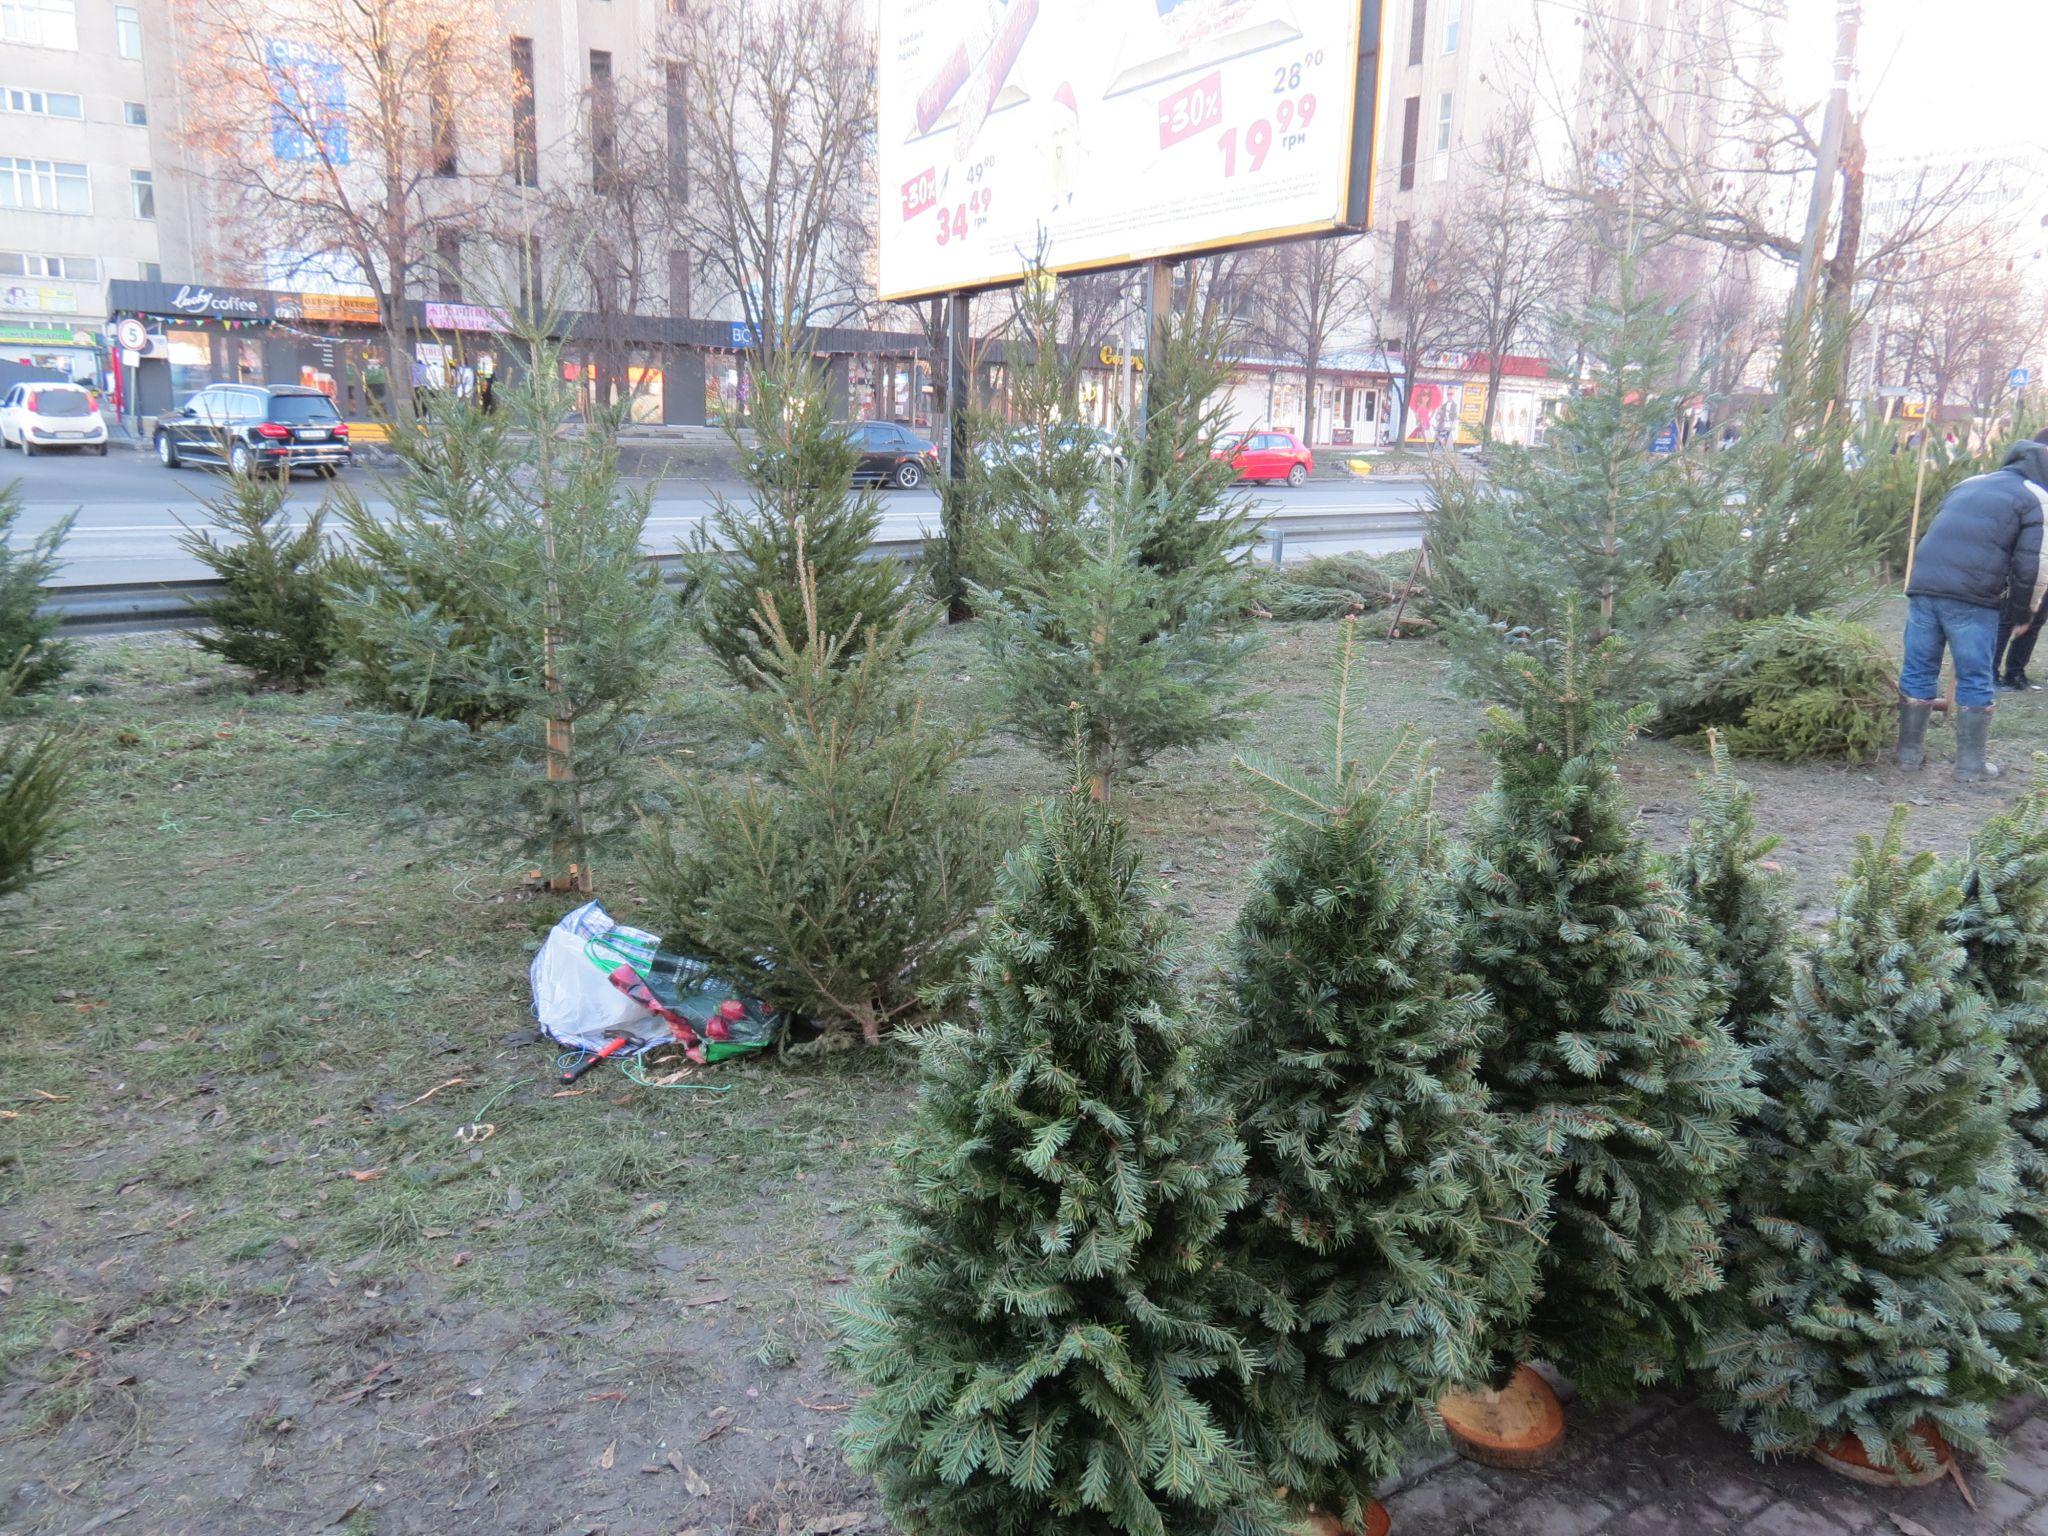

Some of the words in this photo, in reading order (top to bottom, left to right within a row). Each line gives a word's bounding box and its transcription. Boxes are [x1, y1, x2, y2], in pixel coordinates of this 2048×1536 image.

[1273, 61, 1303, 95] 28
[1159, 88, 1220, 133] -30%
[1217, 118, 1273, 178] 19
[1276, 93, 1319, 135] 99
[1281, 132, 1307, 152] грн
[967, 163, 984, 185] 49
[901, 172, 936, 210] -30%
[936, 194, 970, 247] 34
[969, 187, 993, 215] 49
[974, 216, 988, 230] грн
[211, 296, 258, 314] coffee
[128, 327, 138, 343] 5
